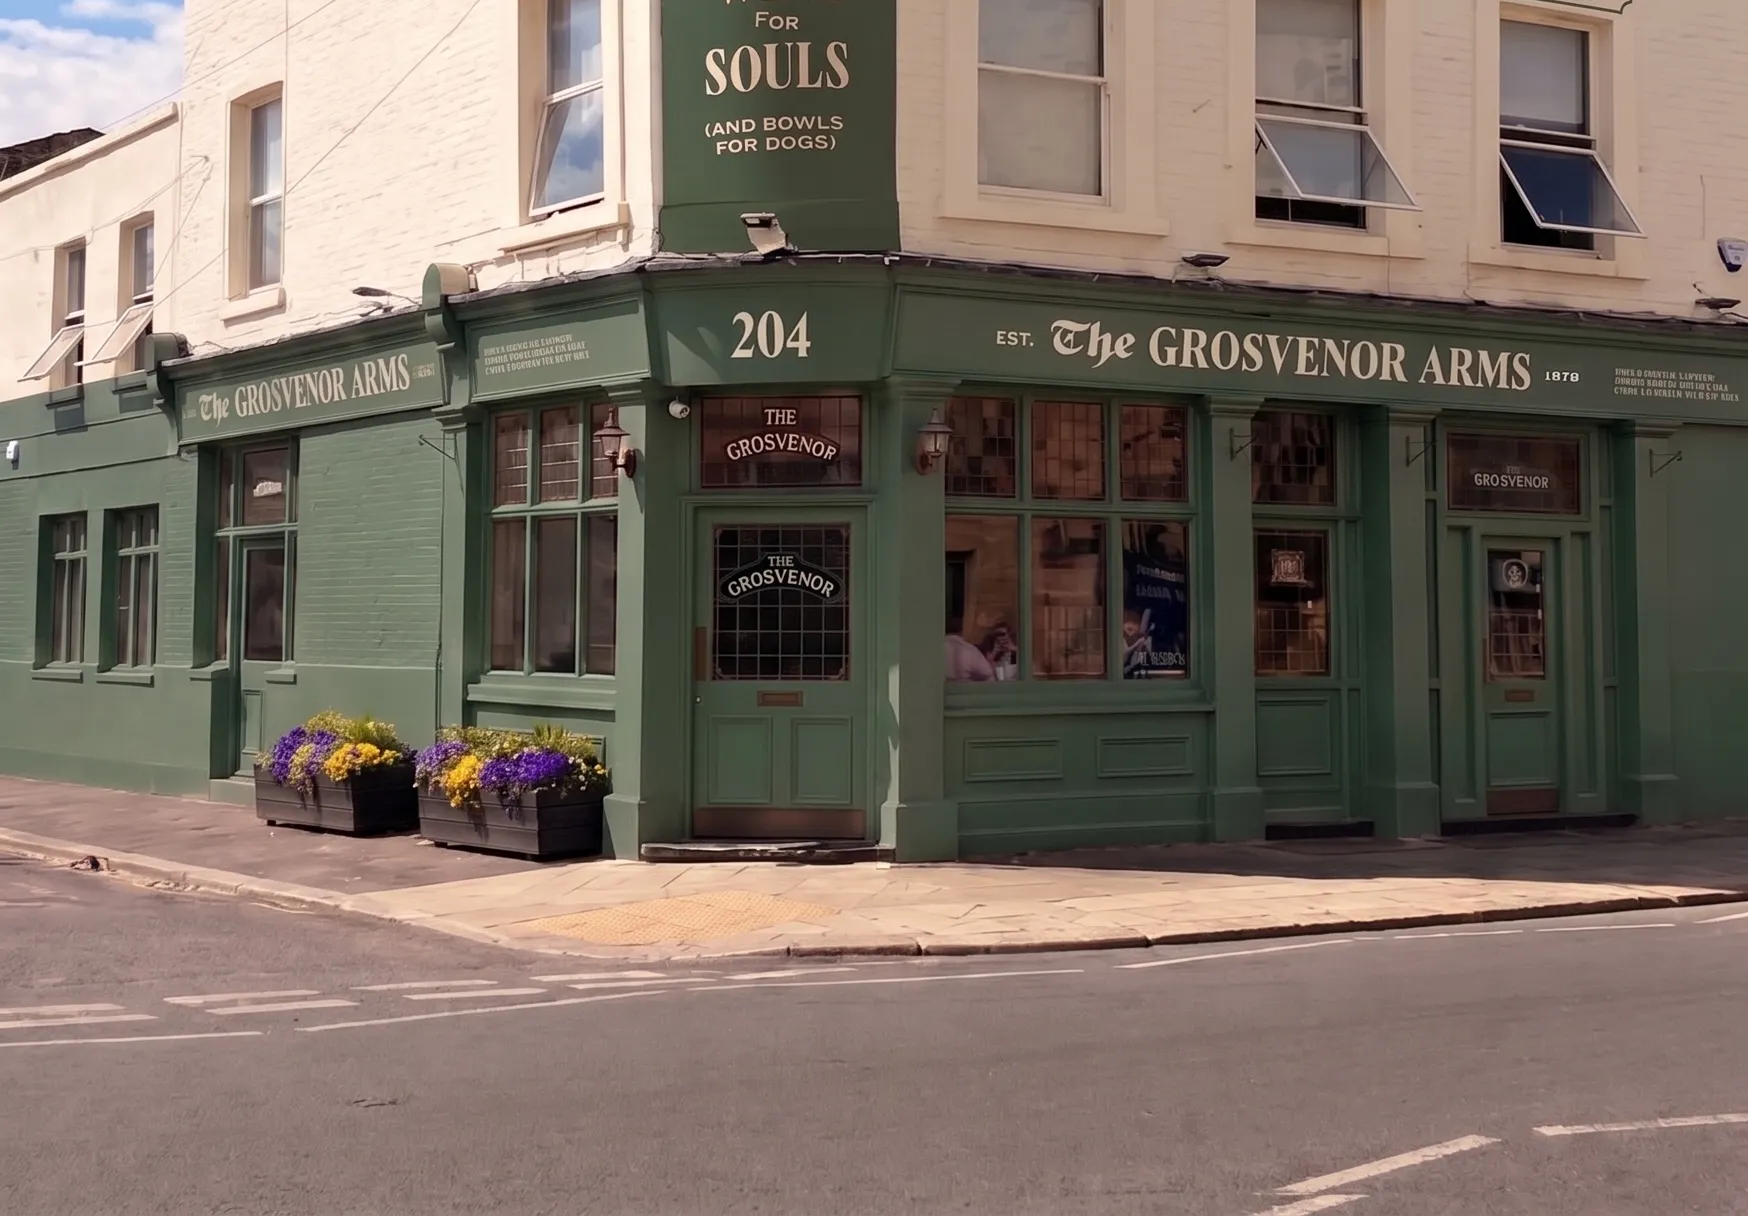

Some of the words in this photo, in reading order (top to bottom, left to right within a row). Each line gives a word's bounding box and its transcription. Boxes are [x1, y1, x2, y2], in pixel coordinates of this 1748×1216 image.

[705, 41, 850, 96] SOULS
[705, 118, 756, 138] (AND
[763, 116, 844, 131] BOWLS
[716, 138, 758, 155] FOR
[766, 135, 836, 151] DOGS)
[730, 310, 811, 359] 204
[996, 331, 1034, 347] EST.
[1050, 319, 1136, 369] The
[1149, 326, 1408, 383] GROSVENOR
[1418, 344, 1531, 391] ARMS
[1545, 371, 1580, 383] 1878
[199, 392, 230, 428] The
[235, 367, 347, 418] GROSVENOR
[351, 353, 410, 399] ARMS
[764, 409, 797, 425] THE
[727, 433, 837, 461] GROSVENOR
[1474, 473, 1549, 489] GROSVENOR
[767, 556, 794, 567] THE
[728, 569, 834, 598] GROSVENOR
